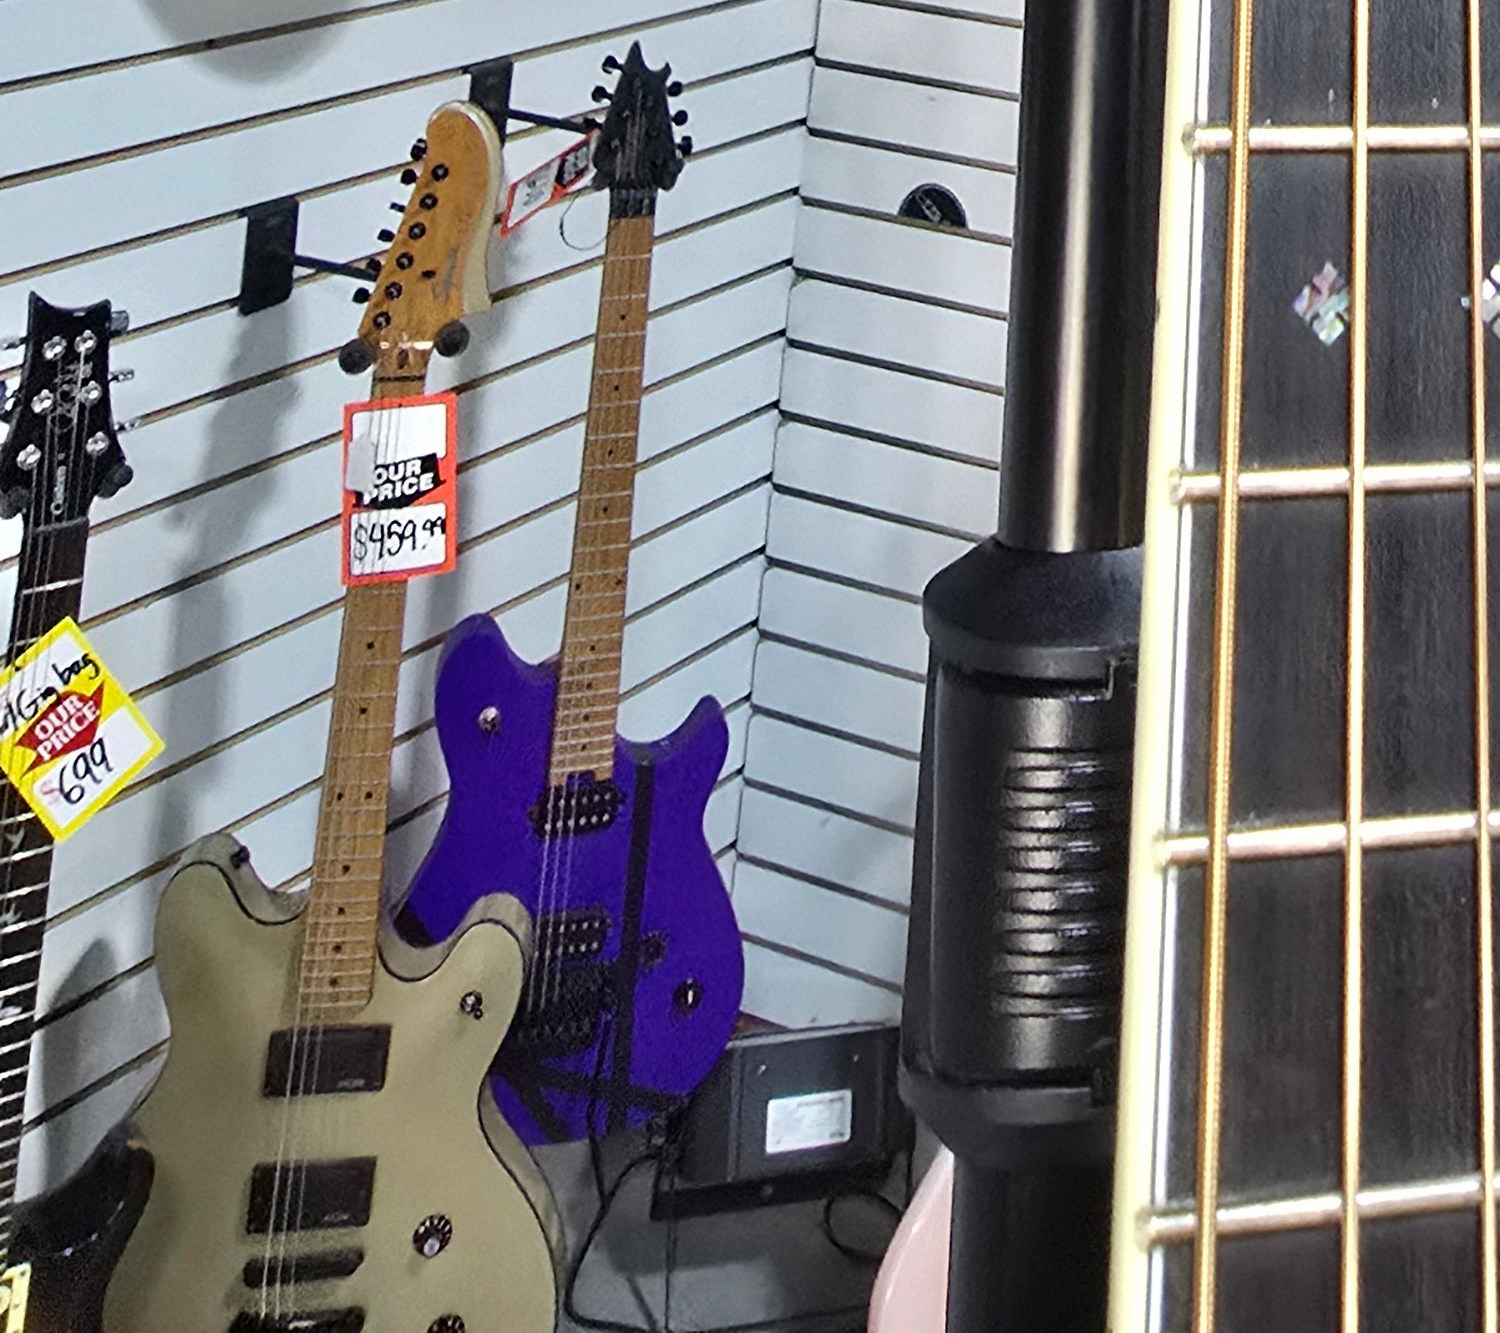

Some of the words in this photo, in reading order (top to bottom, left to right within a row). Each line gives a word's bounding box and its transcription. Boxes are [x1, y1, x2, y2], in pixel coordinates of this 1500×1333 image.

[362, 472, 435, 506] PRICE
[374, 458, 422, 485] OUR
[34, 694, 87, 741] OUR
[37, 699, 101, 762] PRICE
